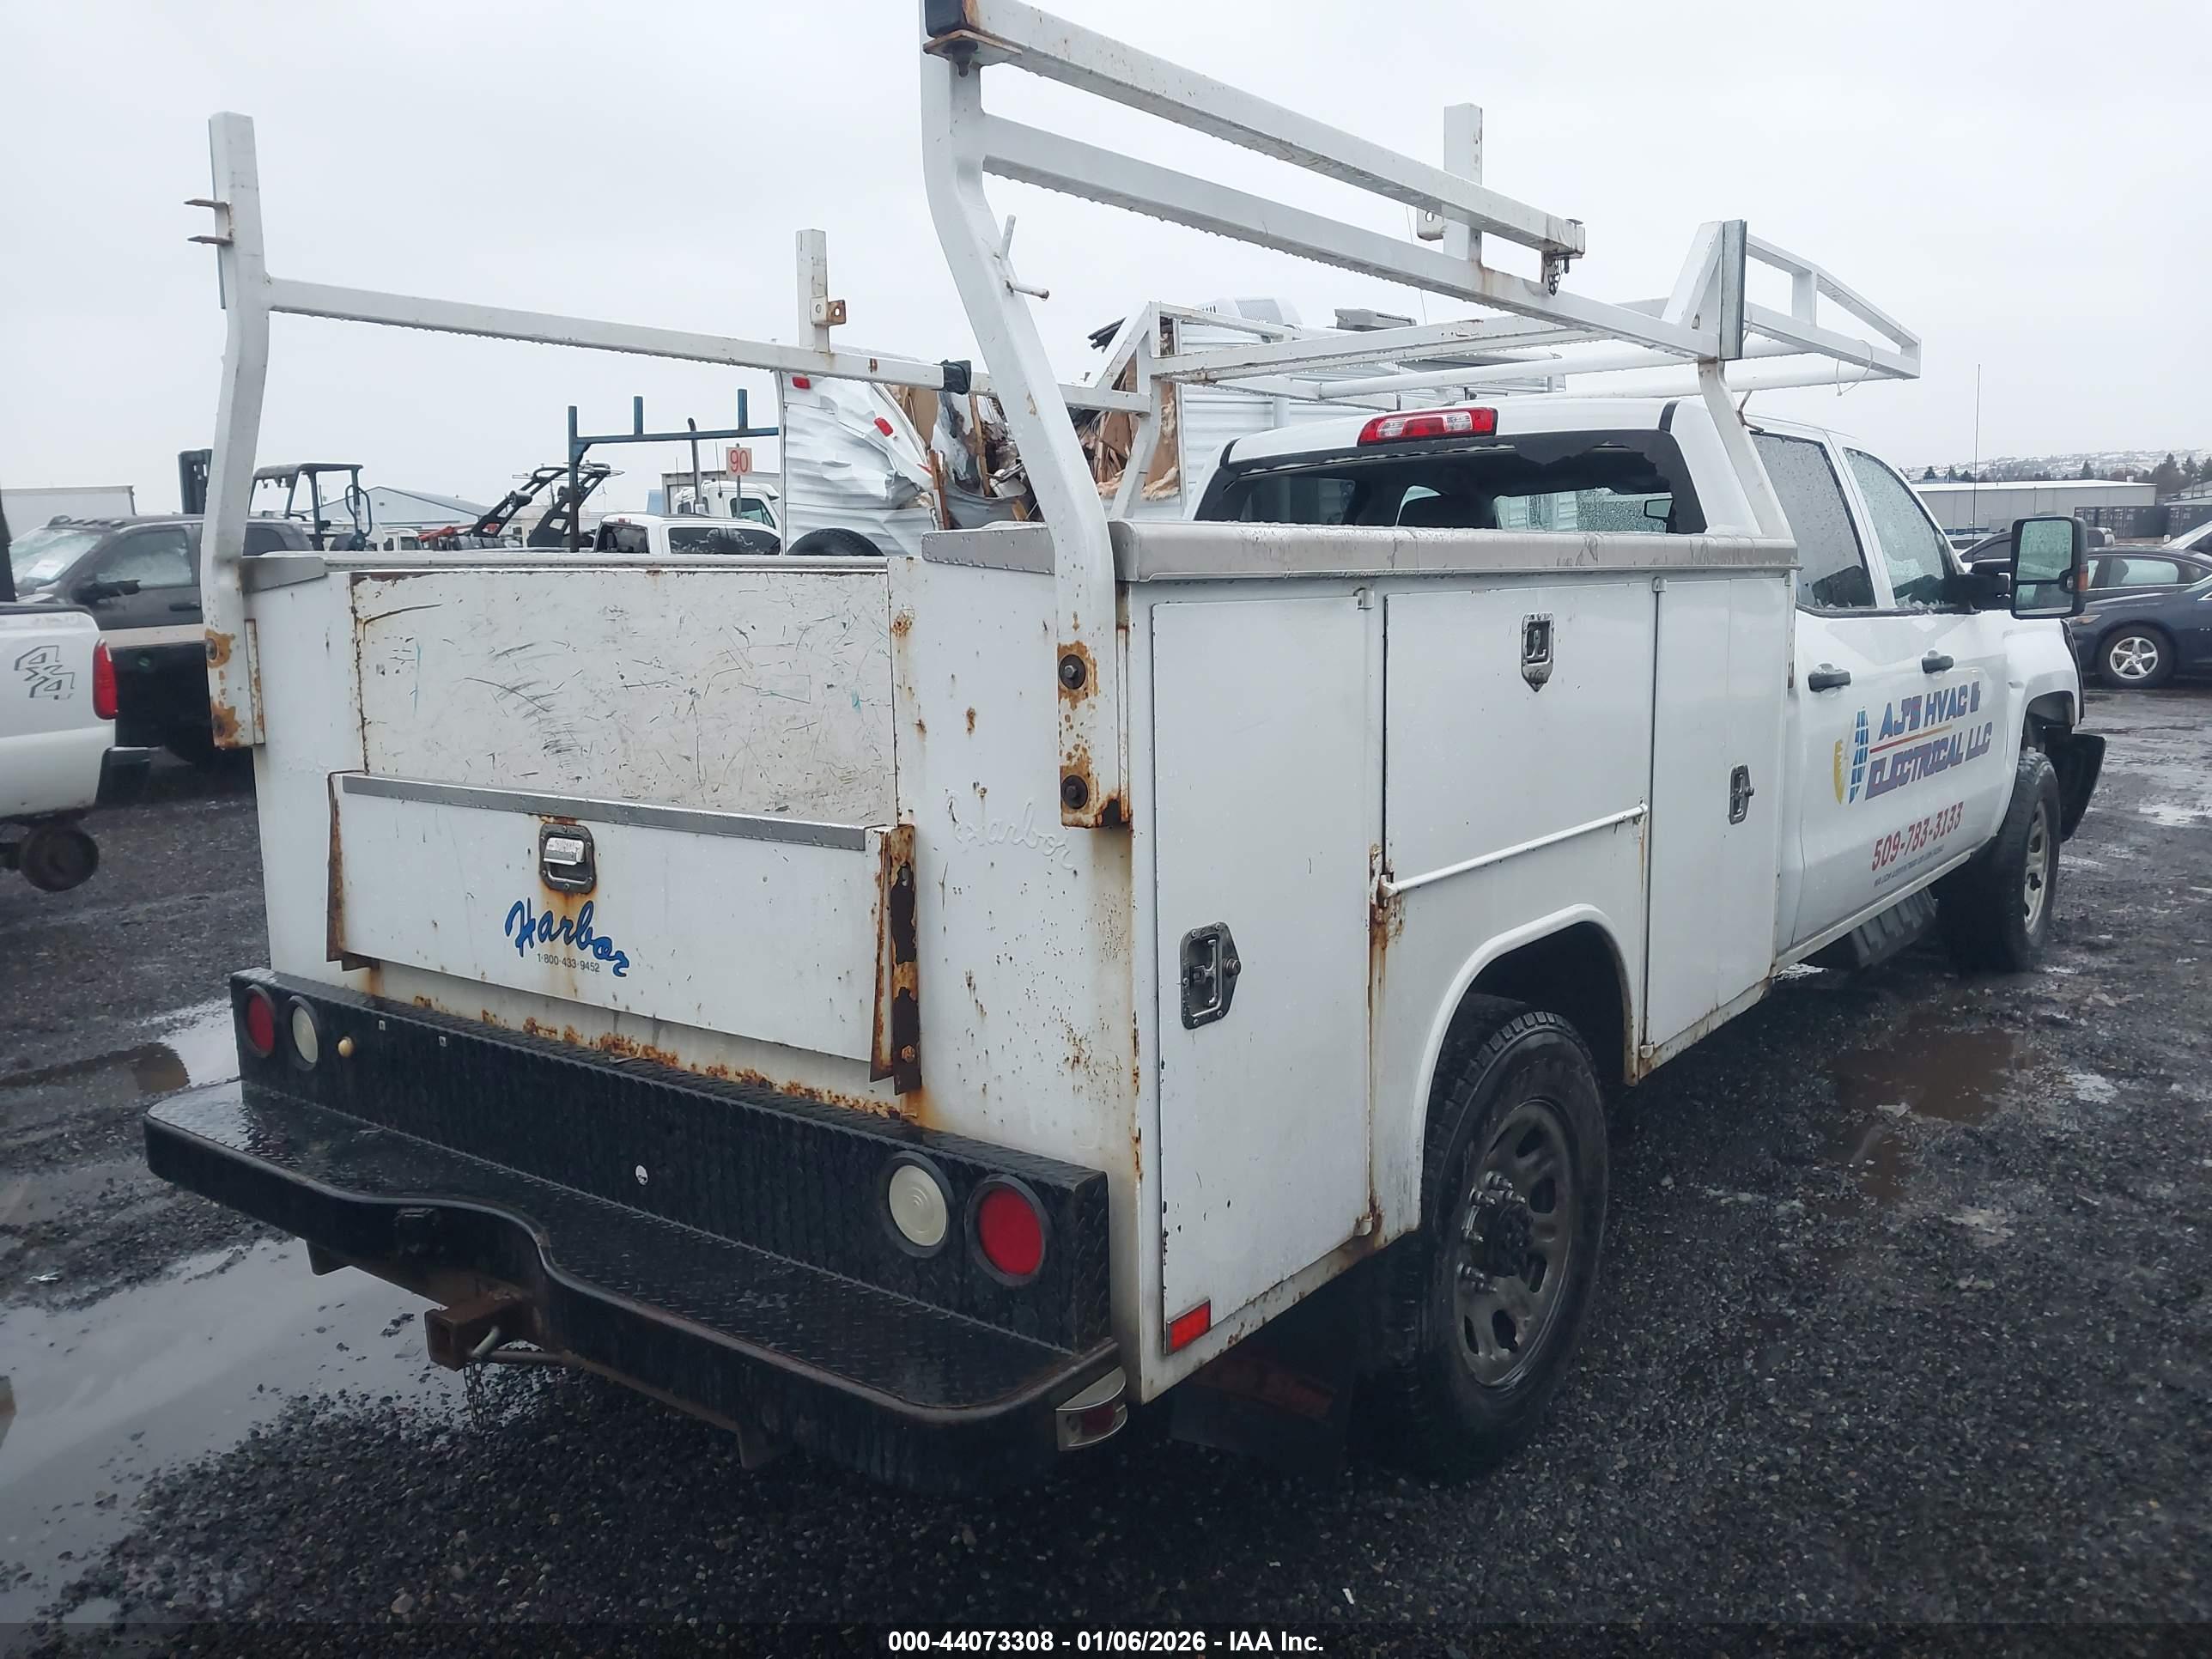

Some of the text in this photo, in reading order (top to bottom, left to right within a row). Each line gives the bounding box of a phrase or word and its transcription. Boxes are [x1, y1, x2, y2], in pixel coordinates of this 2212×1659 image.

[730, 450, 749, 473] 90
[1923, 684, 1968, 727] HVAC
[1865, 722, 1993, 800] ELECTRICAL LLC
[1871, 801, 1965, 872] 509-783-3133
[505, 897, 629, 978] Harbor
